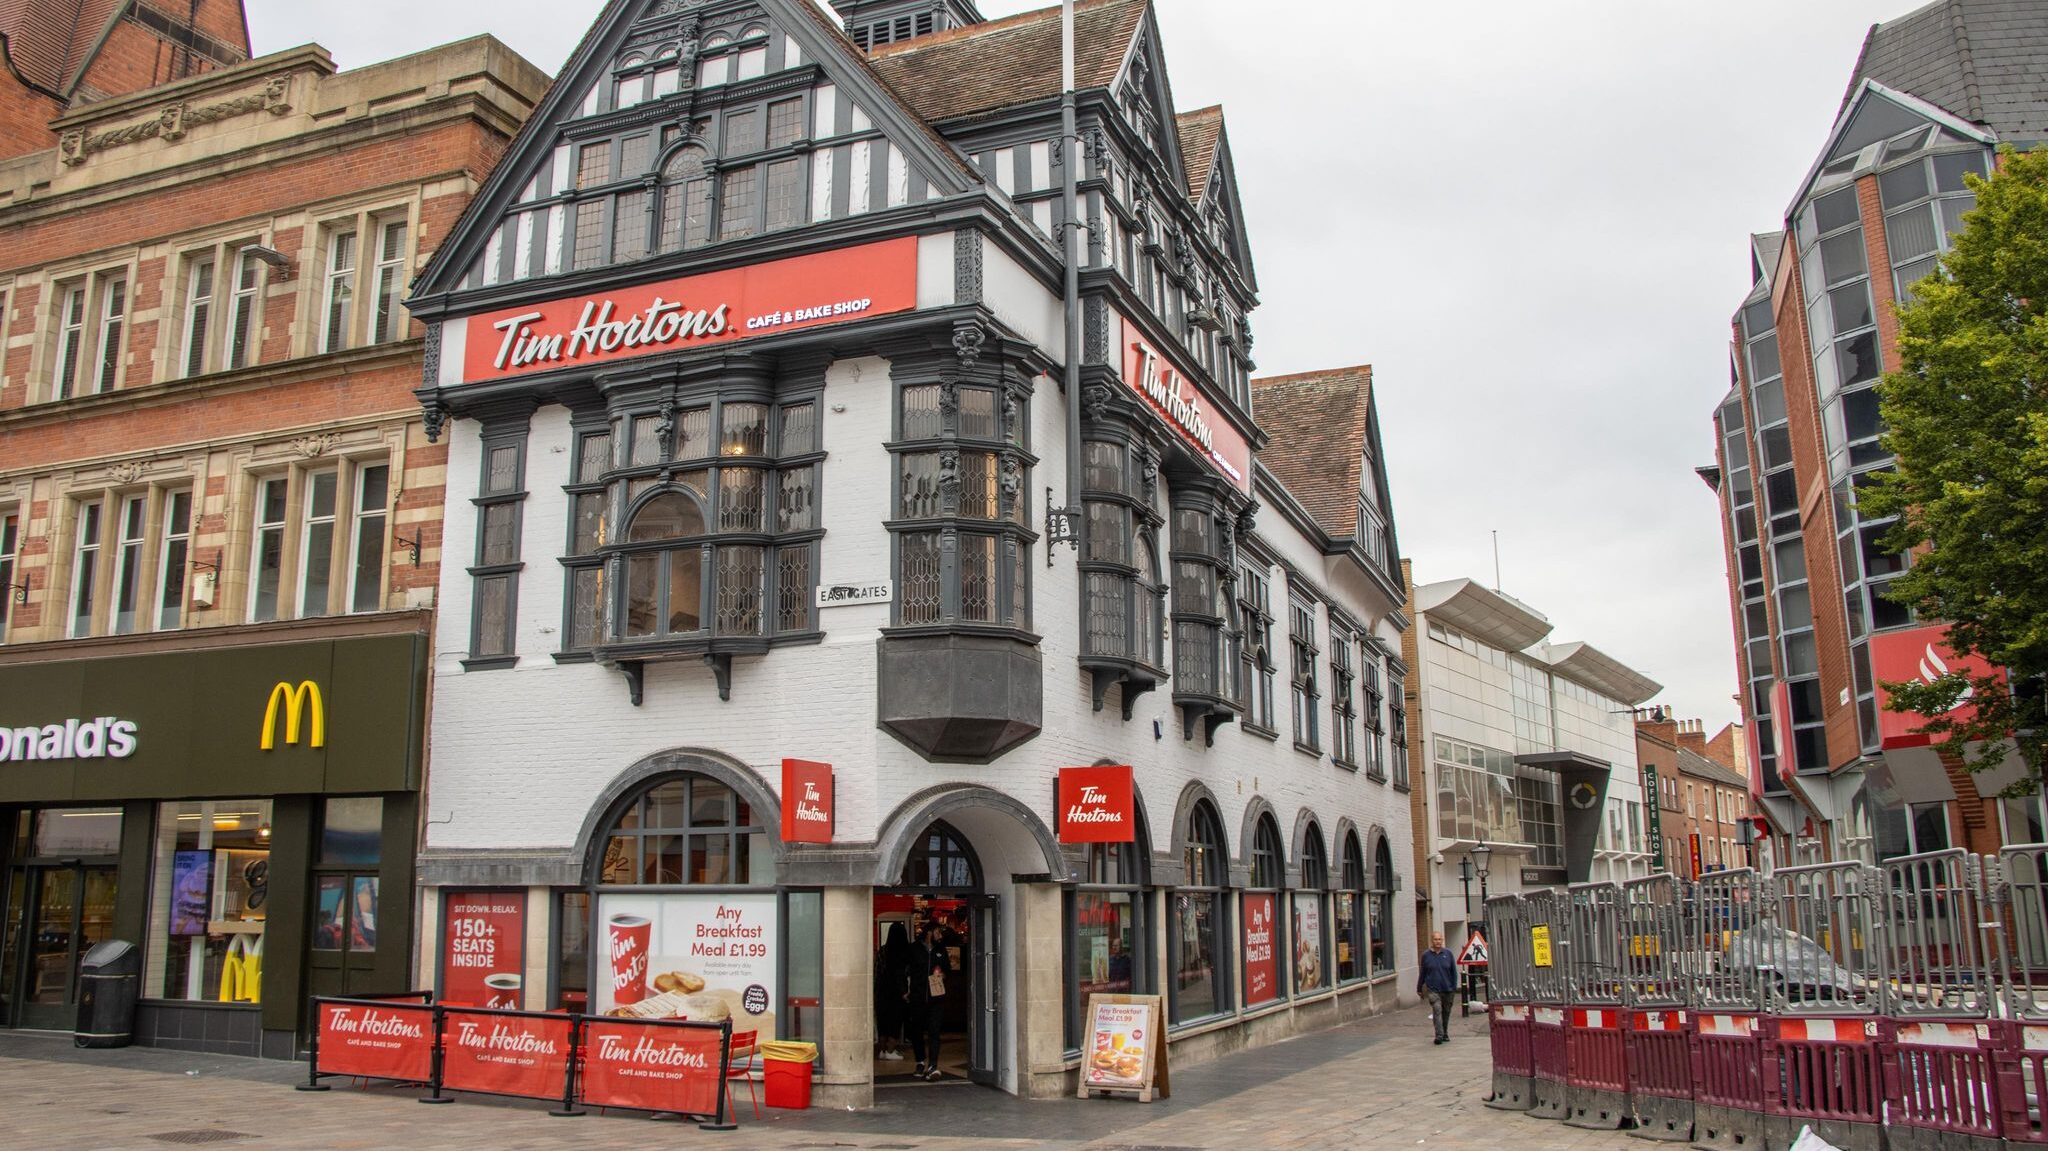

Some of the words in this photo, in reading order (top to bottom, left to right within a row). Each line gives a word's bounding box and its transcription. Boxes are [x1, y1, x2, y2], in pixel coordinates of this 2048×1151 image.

[747, 311, 781, 329] CAFÉ
[783, 312, 793, 323] &
[795, 305, 832, 321] BAKE
[834, 299, 871, 314] SHOP
[494, 311, 564, 369] Tim
[1140, 342, 1167, 408] Tim
[1167, 368, 1212, 451] Hortons
[804, 782, 820, 801] Tim
[1080, 786, 1107, 804] Tim
[1647, 772, 1657, 819] COFFEE
[796, 800, 828, 823] Hortons
[1066, 804, 1122, 823] Hortons
[1652, 826, 1660, 856] SHOP
[454, 905, 464, 913] SIT
[492, 905, 517, 913] RELAX.
[715, 905, 743, 923] Any
[1253, 909, 1262, 926] Any
[453, 918, 495, 937] 150+
[696, 924, 762, 938] Breakfast
[1247, 928, 1269, 945] Breakfast
[453, 938, 495, 953] SEATS
[610, 931, 636, 961] Tim
[691, 942, 726, 957] Meal
[729, 943, 767, 957] £1.99
[1246, 945, 1259, 963] Meal
[452, 954, 494, 968] INSIDE
[745, 1000, 765, 1013] Eggs
[1099, 1007, 1111, 1015] Any
[330, 1008, 356, 1033] Tim
[458, 1022, 486, 1049] Tim
[598, 1035, 630, 1062] Tim
